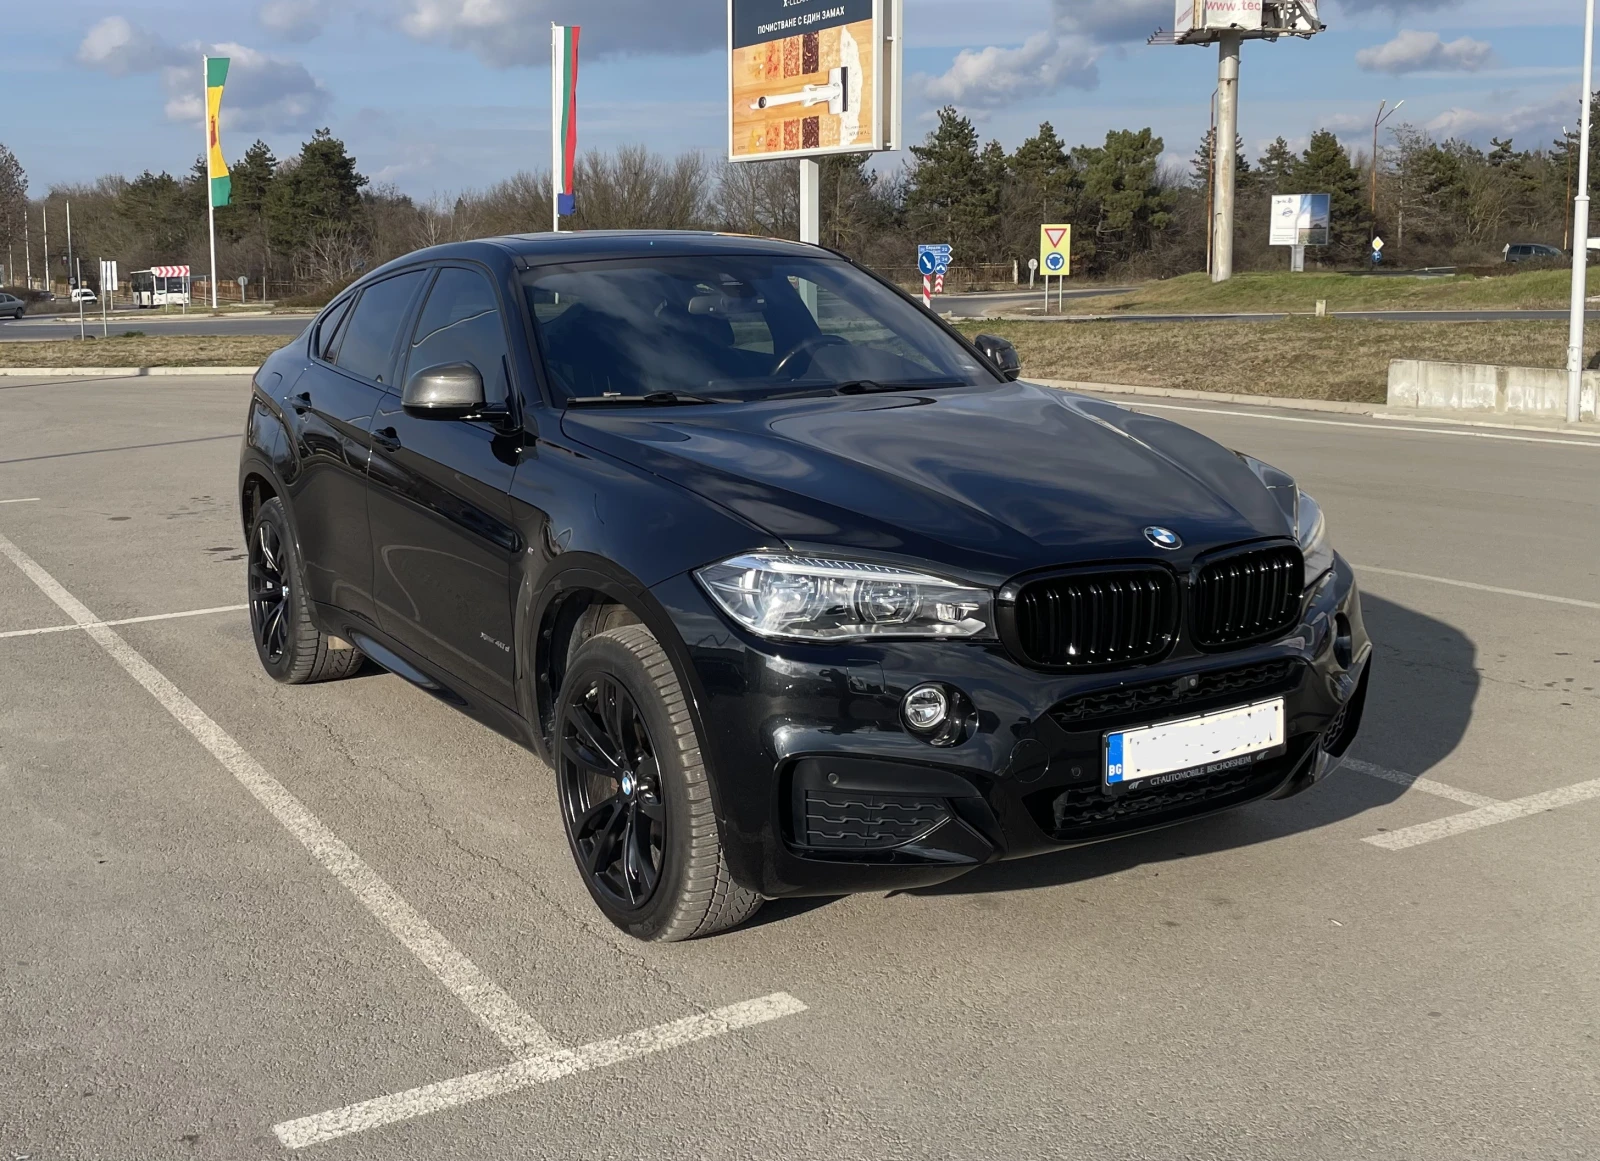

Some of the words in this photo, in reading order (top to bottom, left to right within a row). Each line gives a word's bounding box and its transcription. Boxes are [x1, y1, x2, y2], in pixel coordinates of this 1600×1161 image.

[757, 17, 797, 34] ПОЧИСТВАНЕ
[797, 16, 802, 25] С
[803, 11, 821, 25] ЕДИН
[821, 5, 845, 20] ЗАМАХ
[1108, 763, 1122, 777] BG
[1150, 767, 1204, 785] GT-AUTOMOBILE
[1206, 756, 1252, 773] BISCHOFSHEIM
